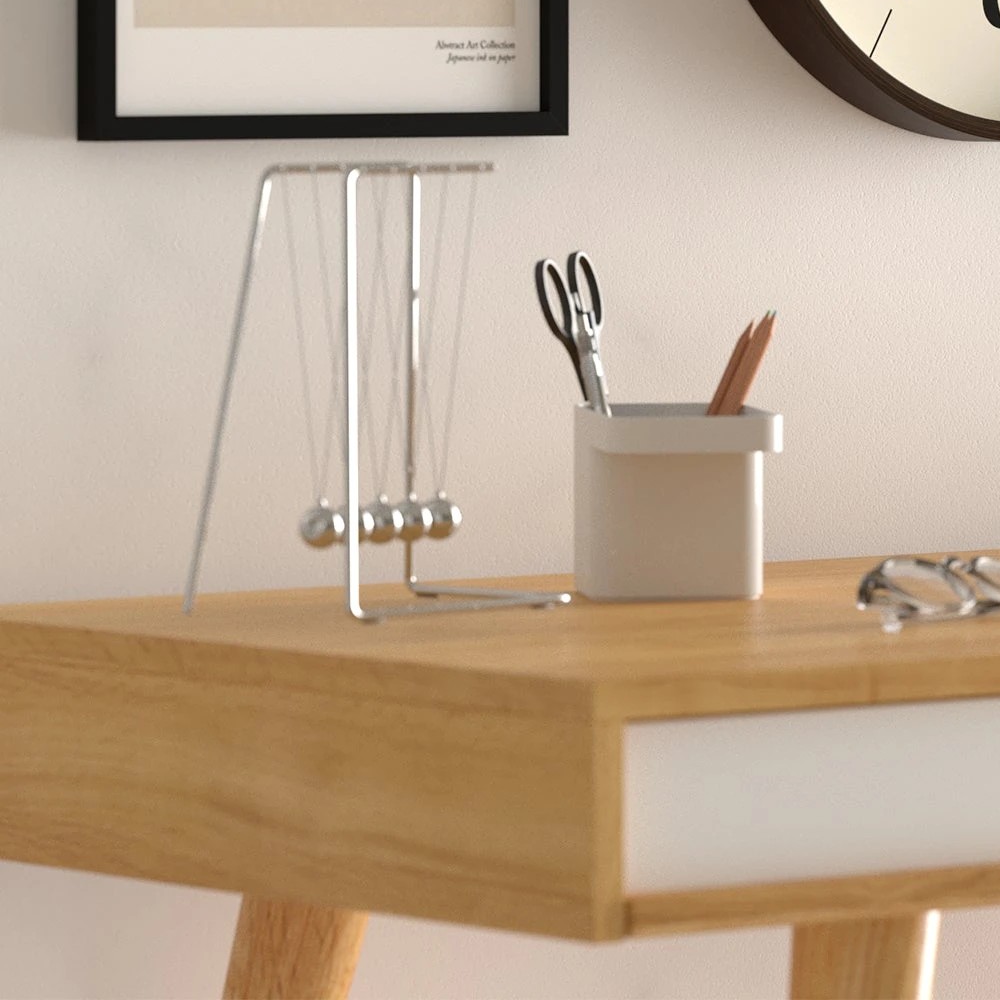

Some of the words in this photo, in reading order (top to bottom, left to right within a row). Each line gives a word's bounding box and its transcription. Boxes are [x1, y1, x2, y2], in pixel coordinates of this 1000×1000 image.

[435, 40, 465, 50] Abstract
[466, 40, 478, 50] Art
[480, 40, 516, 50] Collection
[488, 54, 497, 62] on
[497, 54, 516, 64] paper
